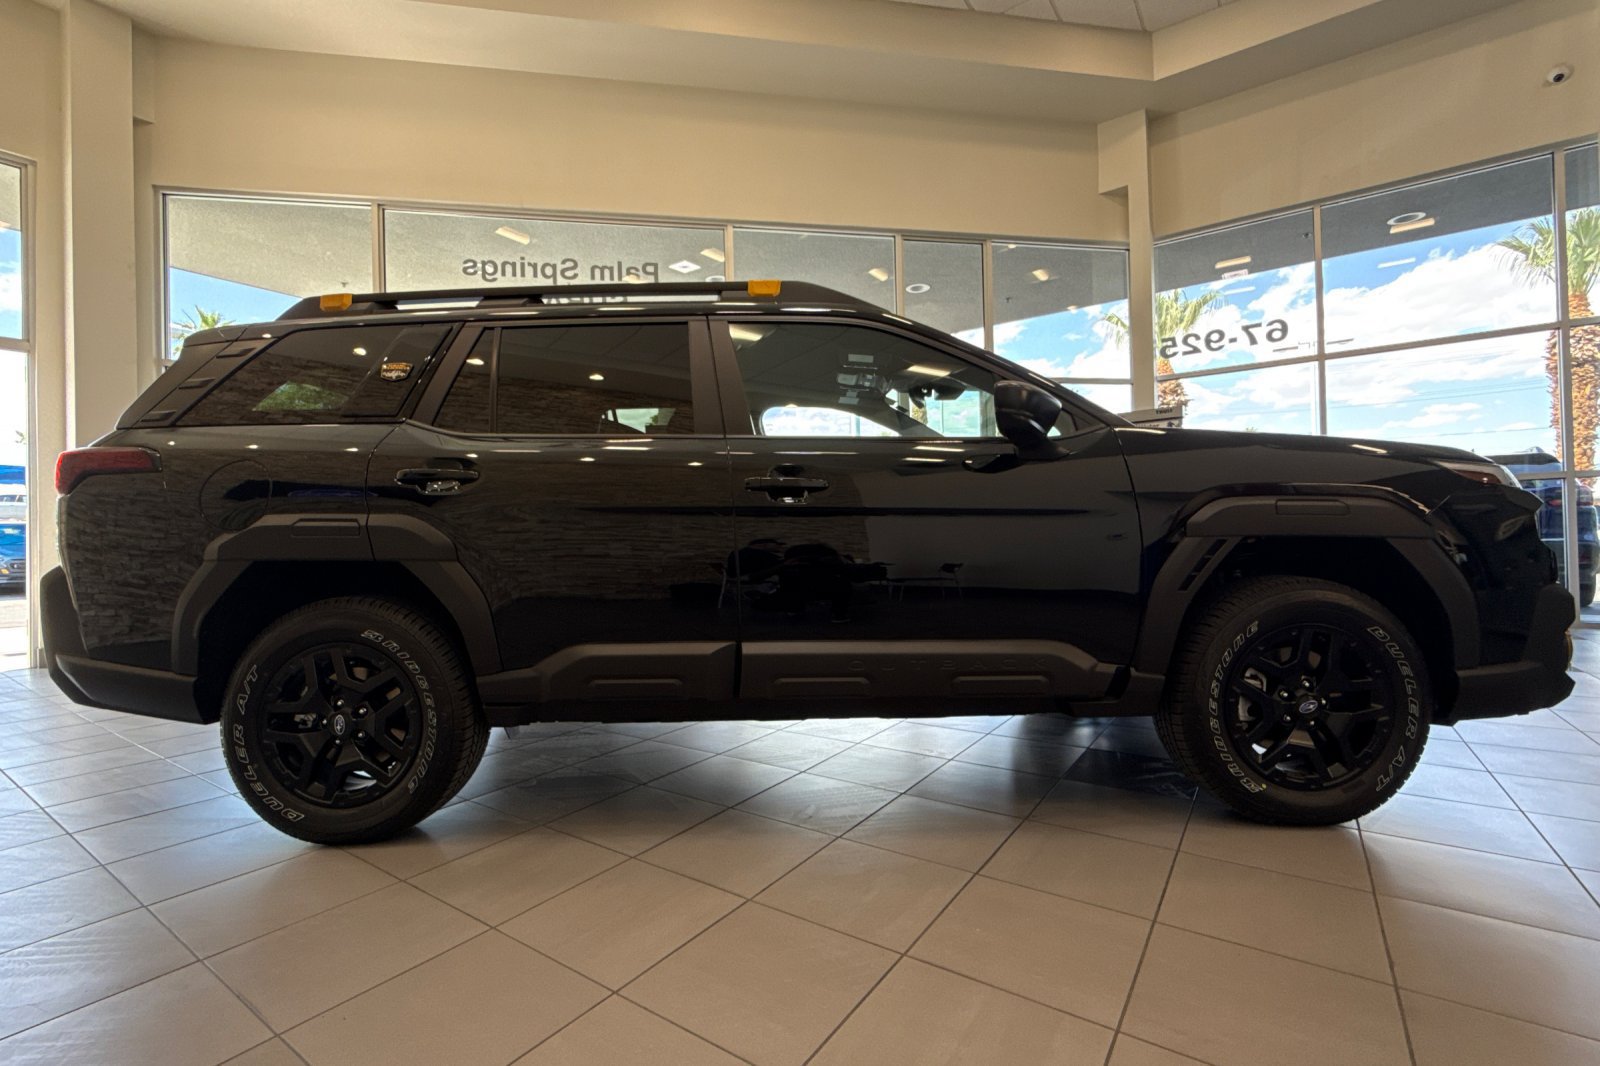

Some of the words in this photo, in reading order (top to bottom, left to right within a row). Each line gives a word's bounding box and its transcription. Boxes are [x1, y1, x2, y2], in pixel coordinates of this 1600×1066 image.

[236, 664, 259, 716] A/T
[361, 629, 437, 794] BRIDGESTONE
[1208, 620, 1264, 793] BRIDGESTONE
[1367, 625, 1419, 739] DUELER
[233, 723, 305, 823] DUELER
[1375, 745, 1406, 792] A/T
